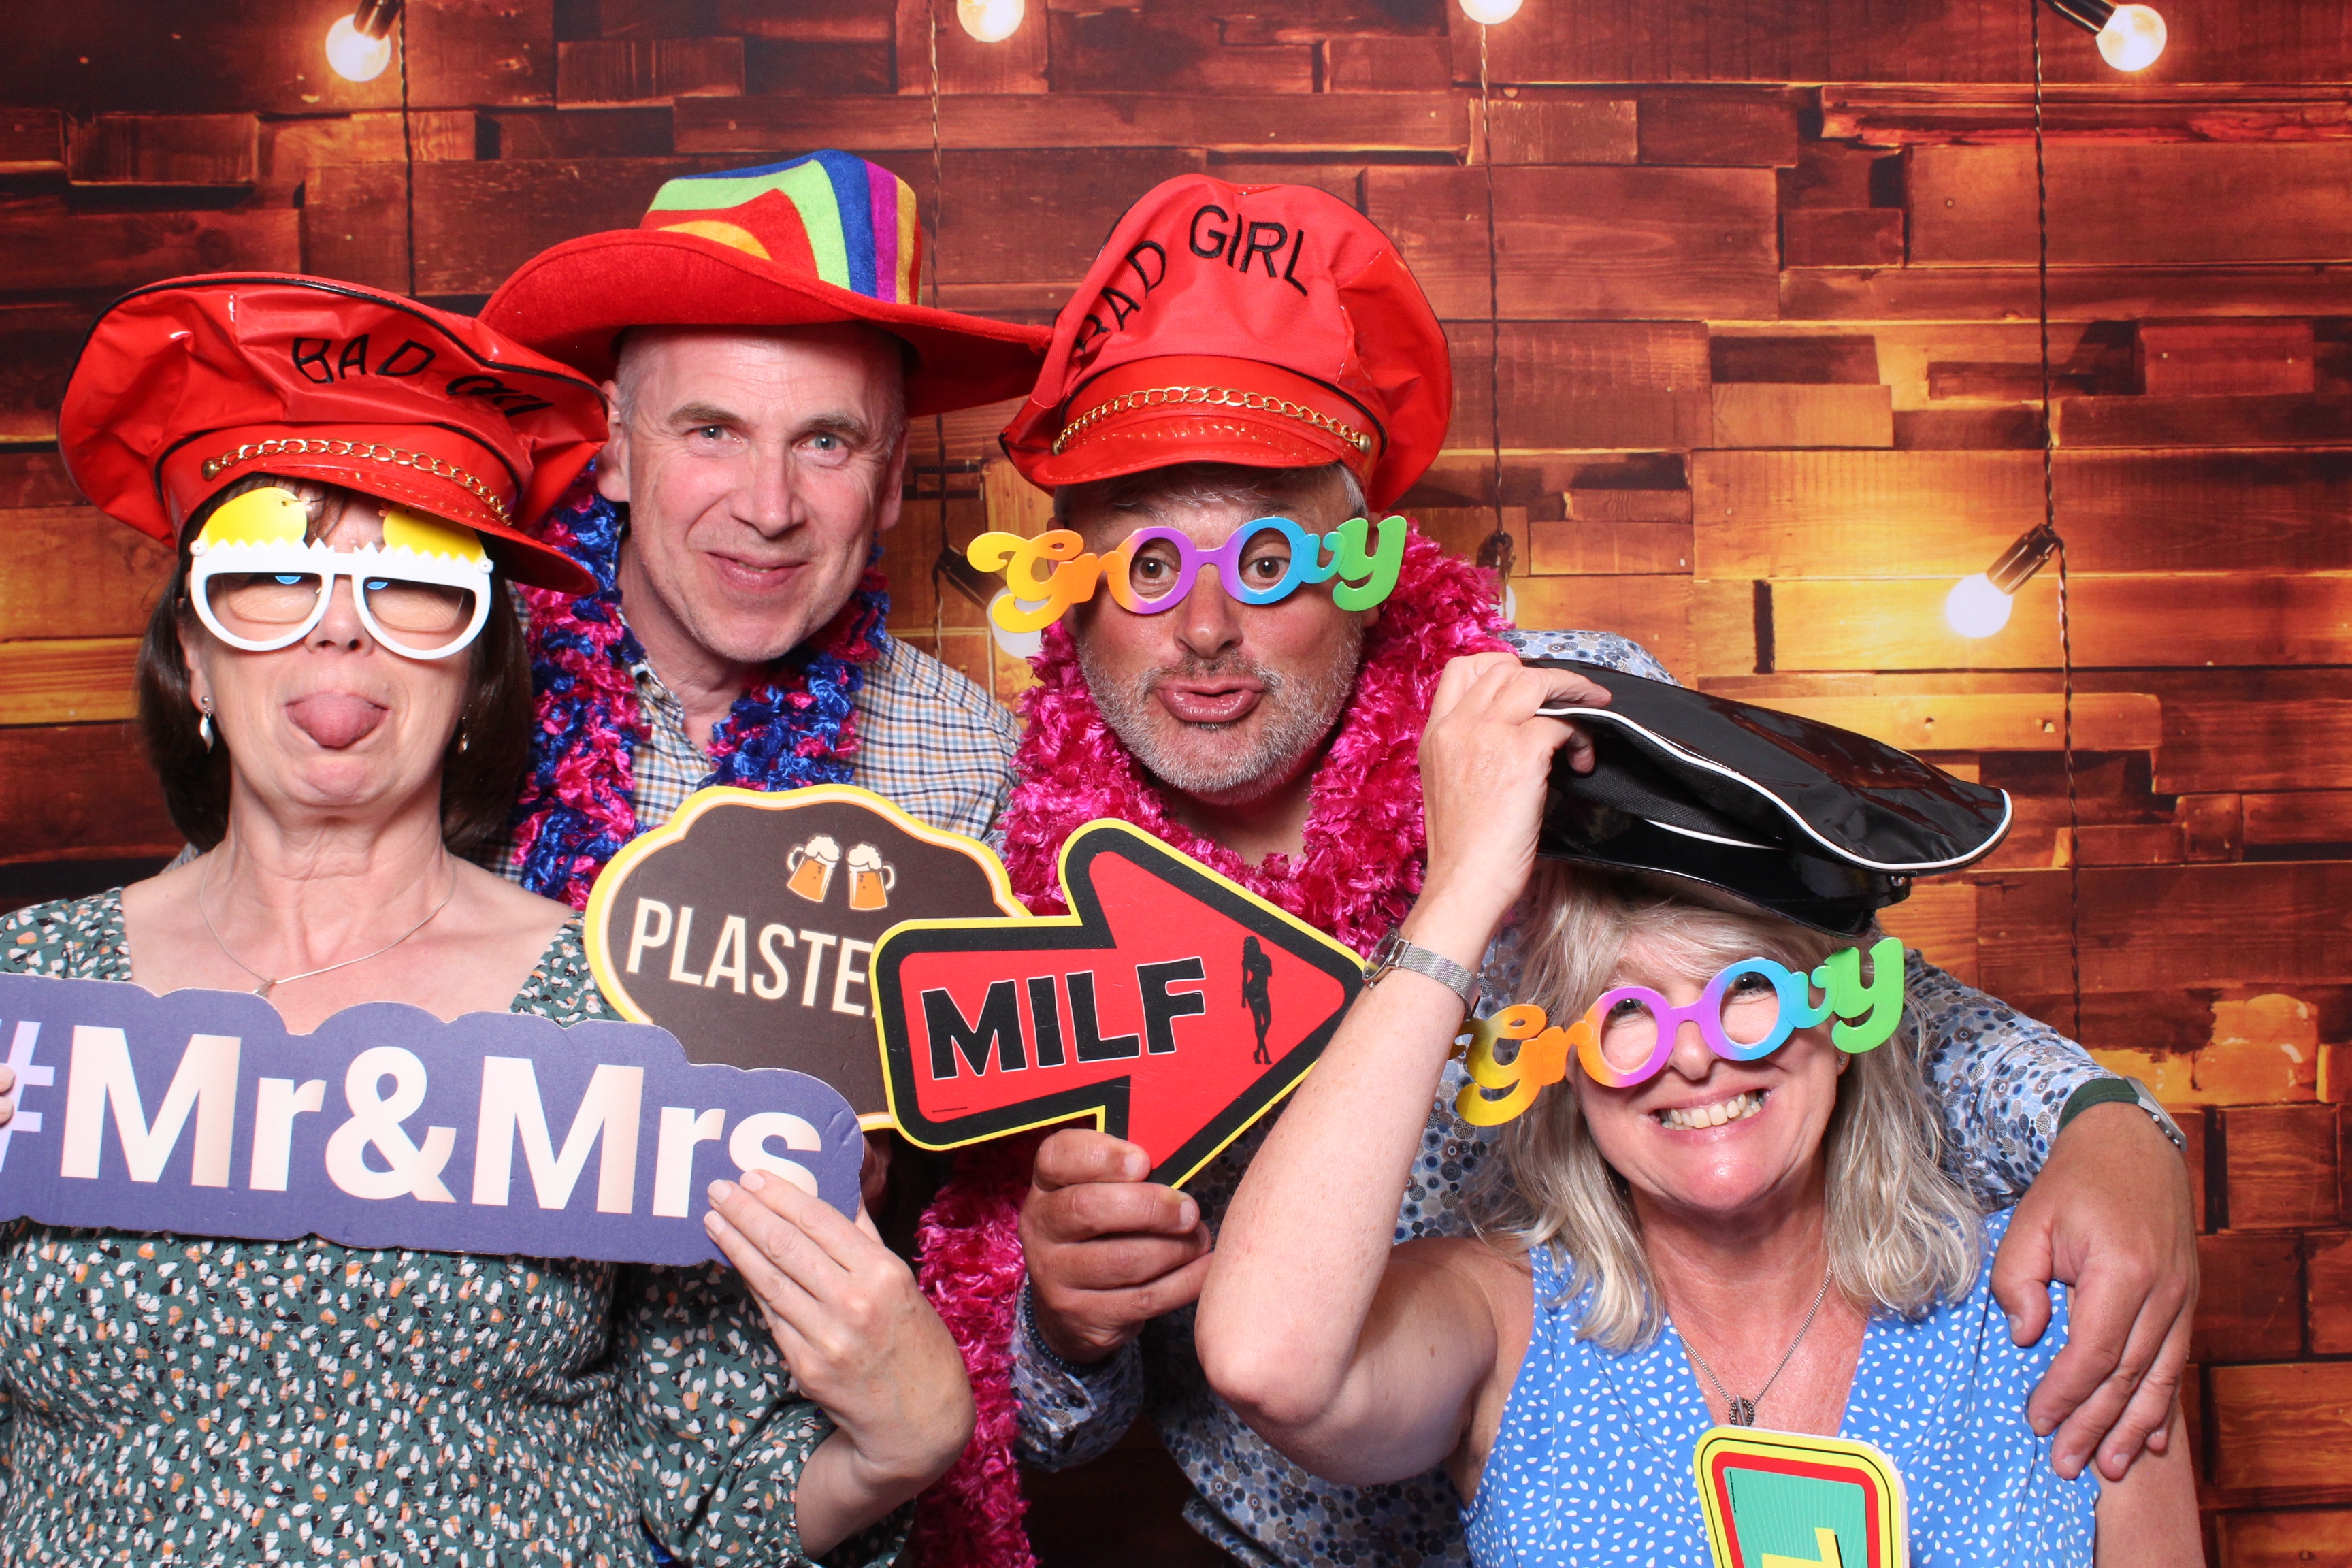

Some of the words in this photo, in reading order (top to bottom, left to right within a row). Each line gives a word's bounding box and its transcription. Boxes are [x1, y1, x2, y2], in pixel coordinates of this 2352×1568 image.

[1189, 204, 1308, 297] GIRL
[291, 336, 436, 385] BAD
[626, 897, 876, 1019] PLASTE
[920, 956, 1207, 1081] MILF
